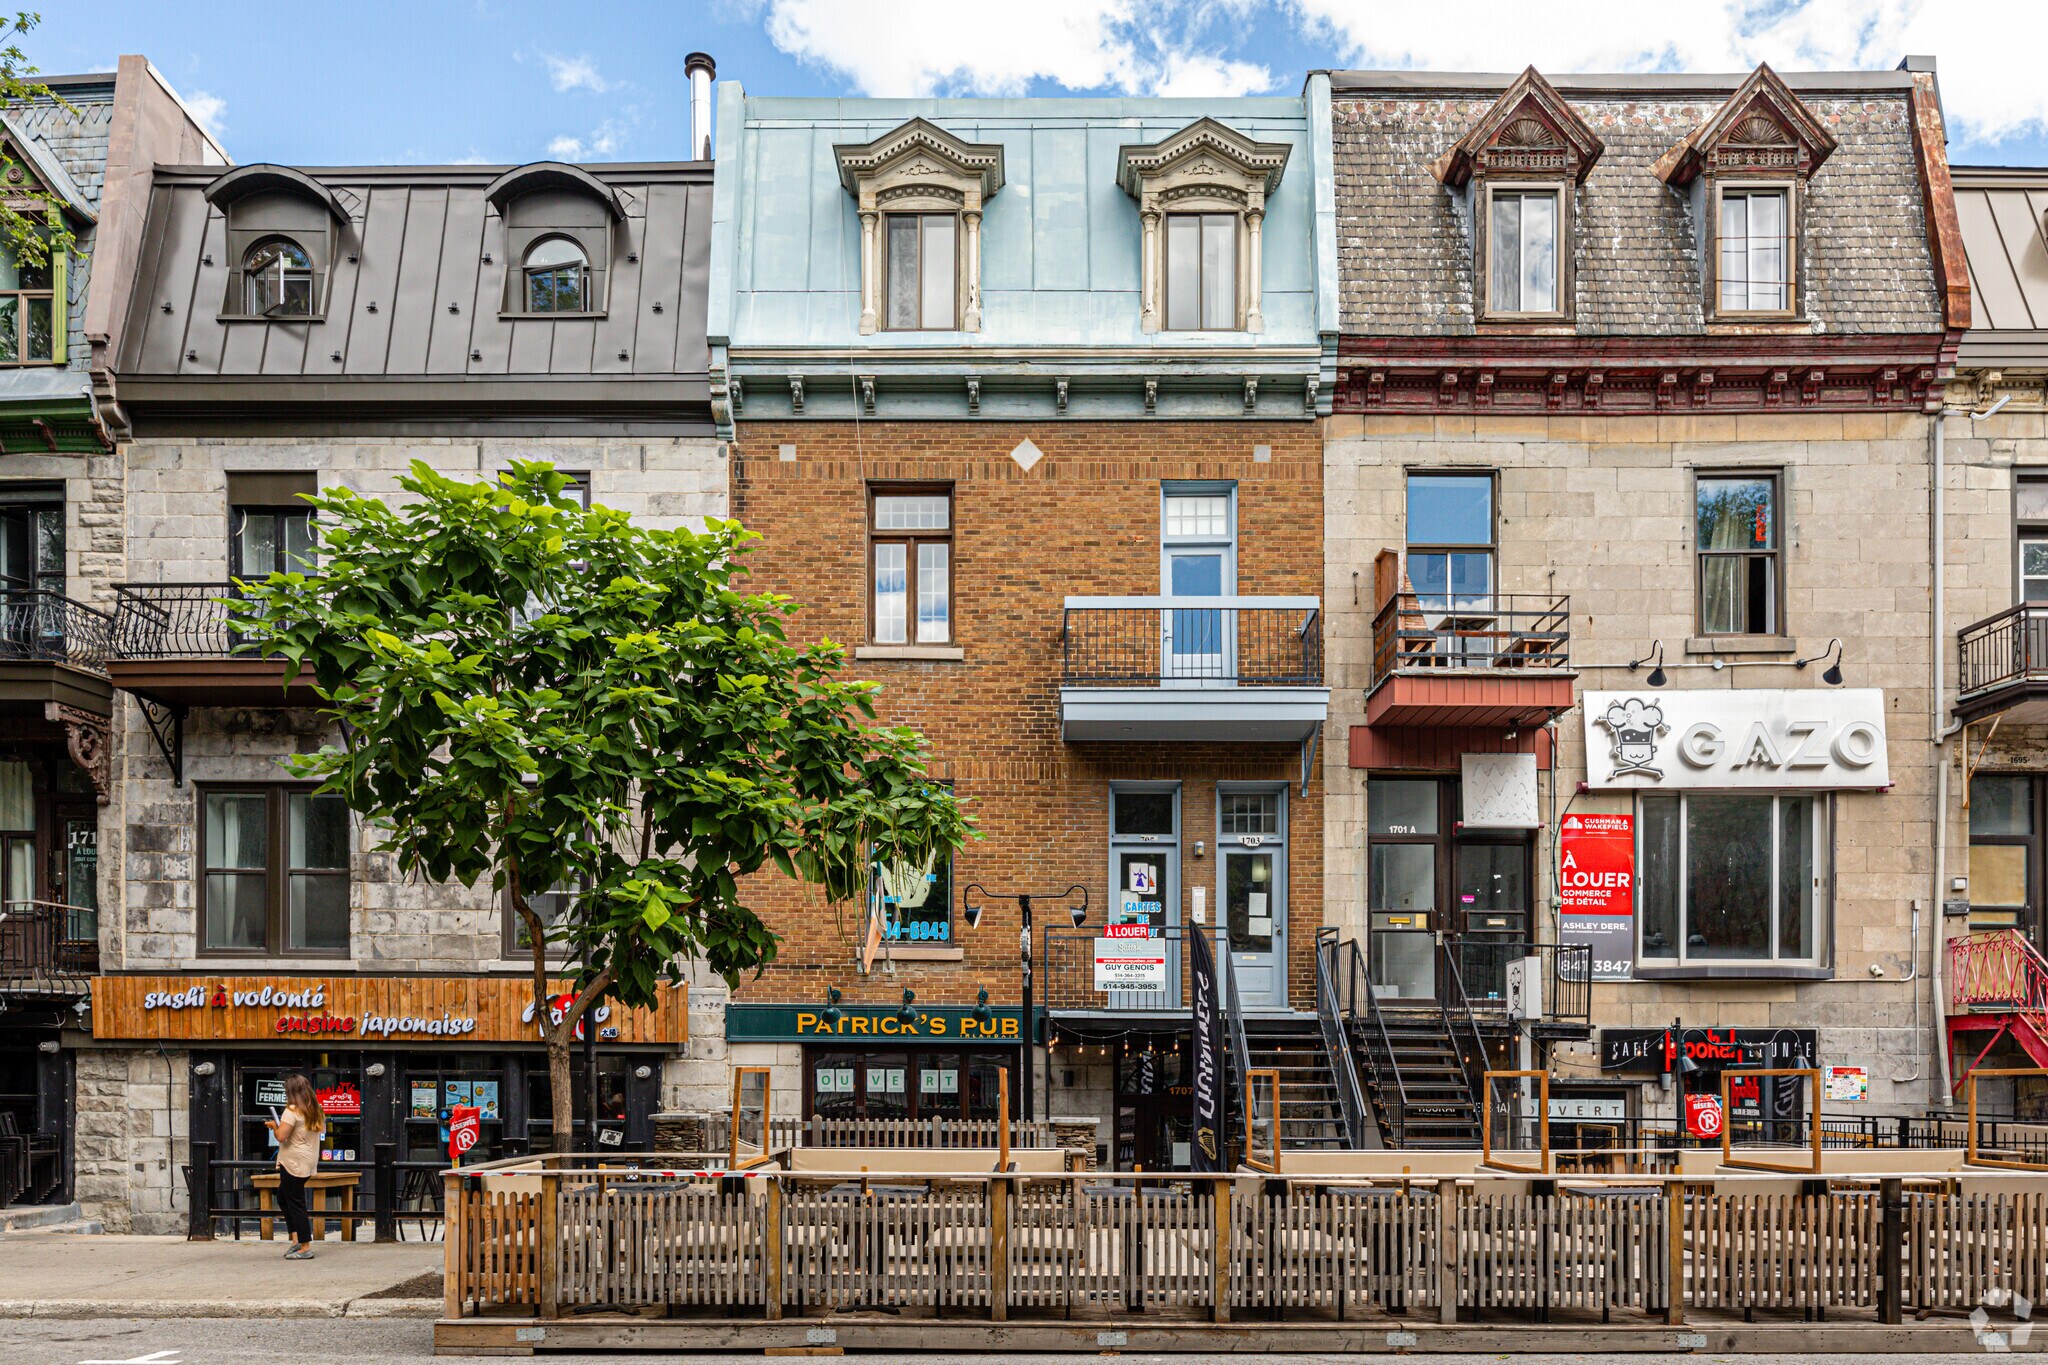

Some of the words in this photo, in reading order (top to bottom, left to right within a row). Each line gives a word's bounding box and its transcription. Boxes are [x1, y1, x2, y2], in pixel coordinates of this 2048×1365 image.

[1680, 721, 1884, 770] GAZO
[1389, 826, 1408, 834] 1701
[1241, 837, 1261, 845] 1703
[1562, 850, 1577, 869] À
[1562, 872, 1631, 888] LOUER
[1562, 889, 1612, 898] COMMERCE
[1125, 901, 1161, 913] CARTES
[1576, 896, 1607, 906] DÉTAIL
[1137, 914, 1149, 924] DE
[1106, 925, 1114, 937] À
[1115, 926, 1147, 937] LOUER
[1562, 922, 1599, 930] ASHLEY
[1600, 922, 1628, 931] DERE,
[1593, 960, 1632, 972] 3847
[144, 986, 206, 1010] sushi
[210, 984, 228, 1007] à
[233, 984, 325, 1008] volonté
[275, 1010, 356, 1033] cuisine
[360, 1011, 476, 1037] japonaise
[960, 1017, 1019, 1035] PUB
[821, 1075, 953, 1086] OUVERT
[1169, 1087, 1194, 1095] 1707
